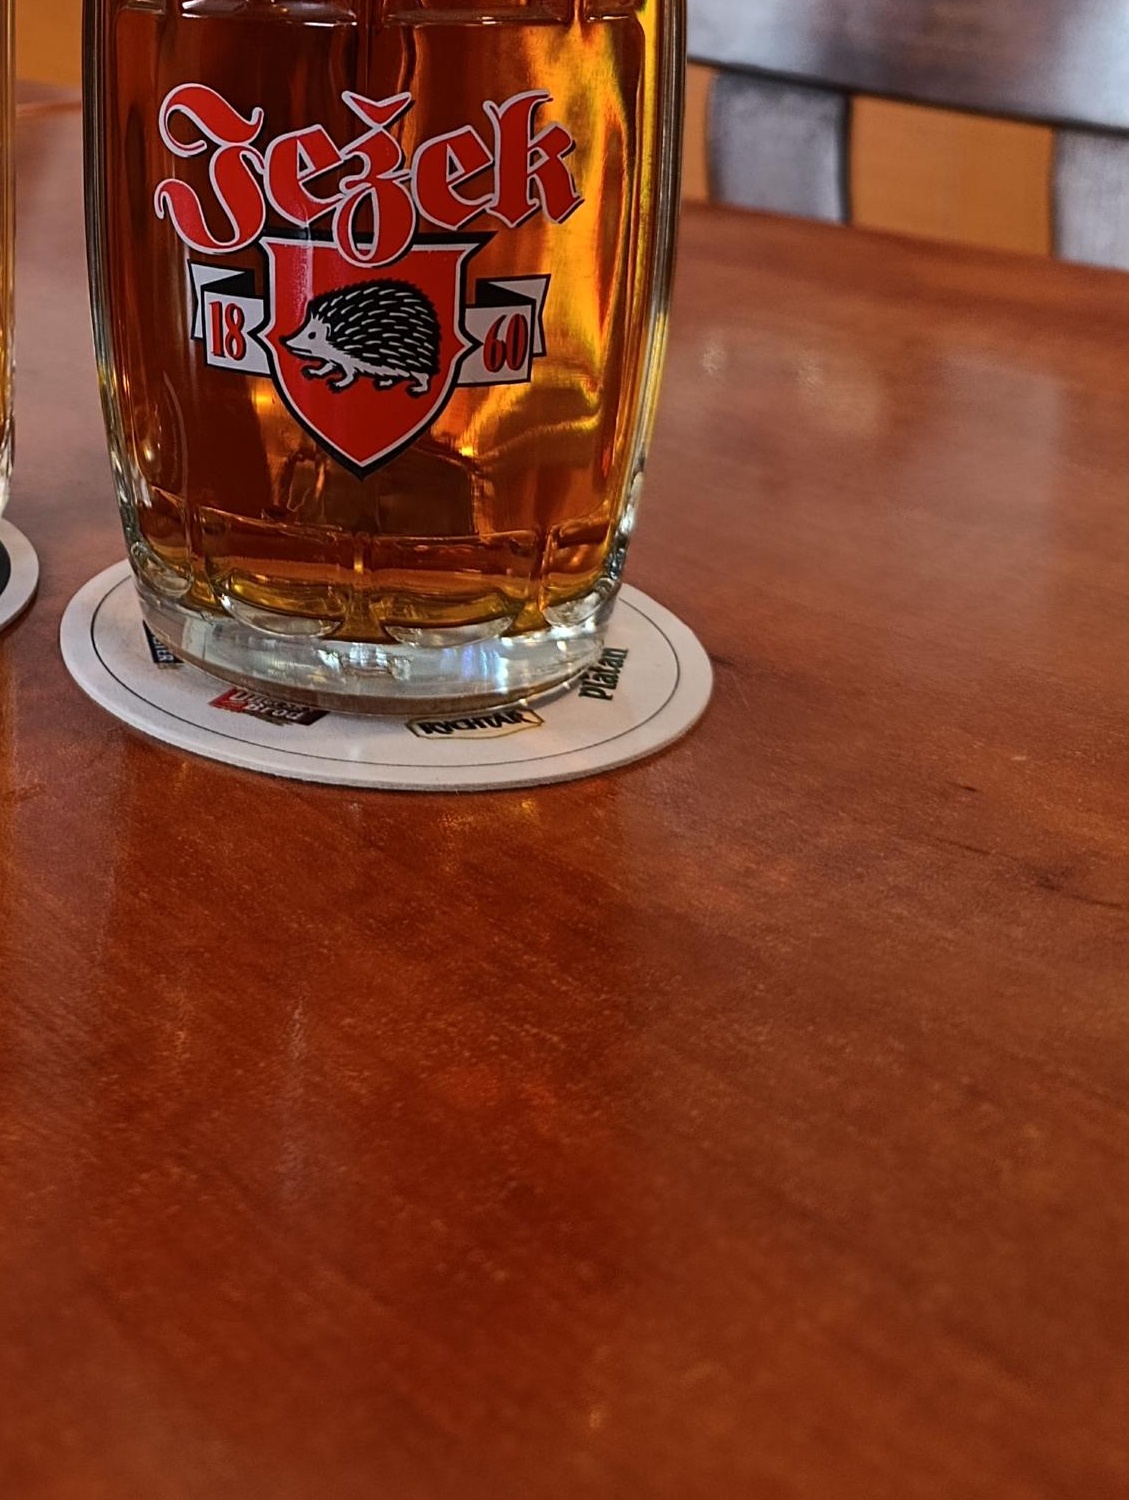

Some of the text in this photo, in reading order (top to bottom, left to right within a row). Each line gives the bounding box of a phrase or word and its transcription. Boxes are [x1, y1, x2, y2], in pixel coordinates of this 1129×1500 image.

[154, 82, 585, 268] Ježek
[208, 300, 529, 373] 18 60
[577, 647, 629, 701] Platan
